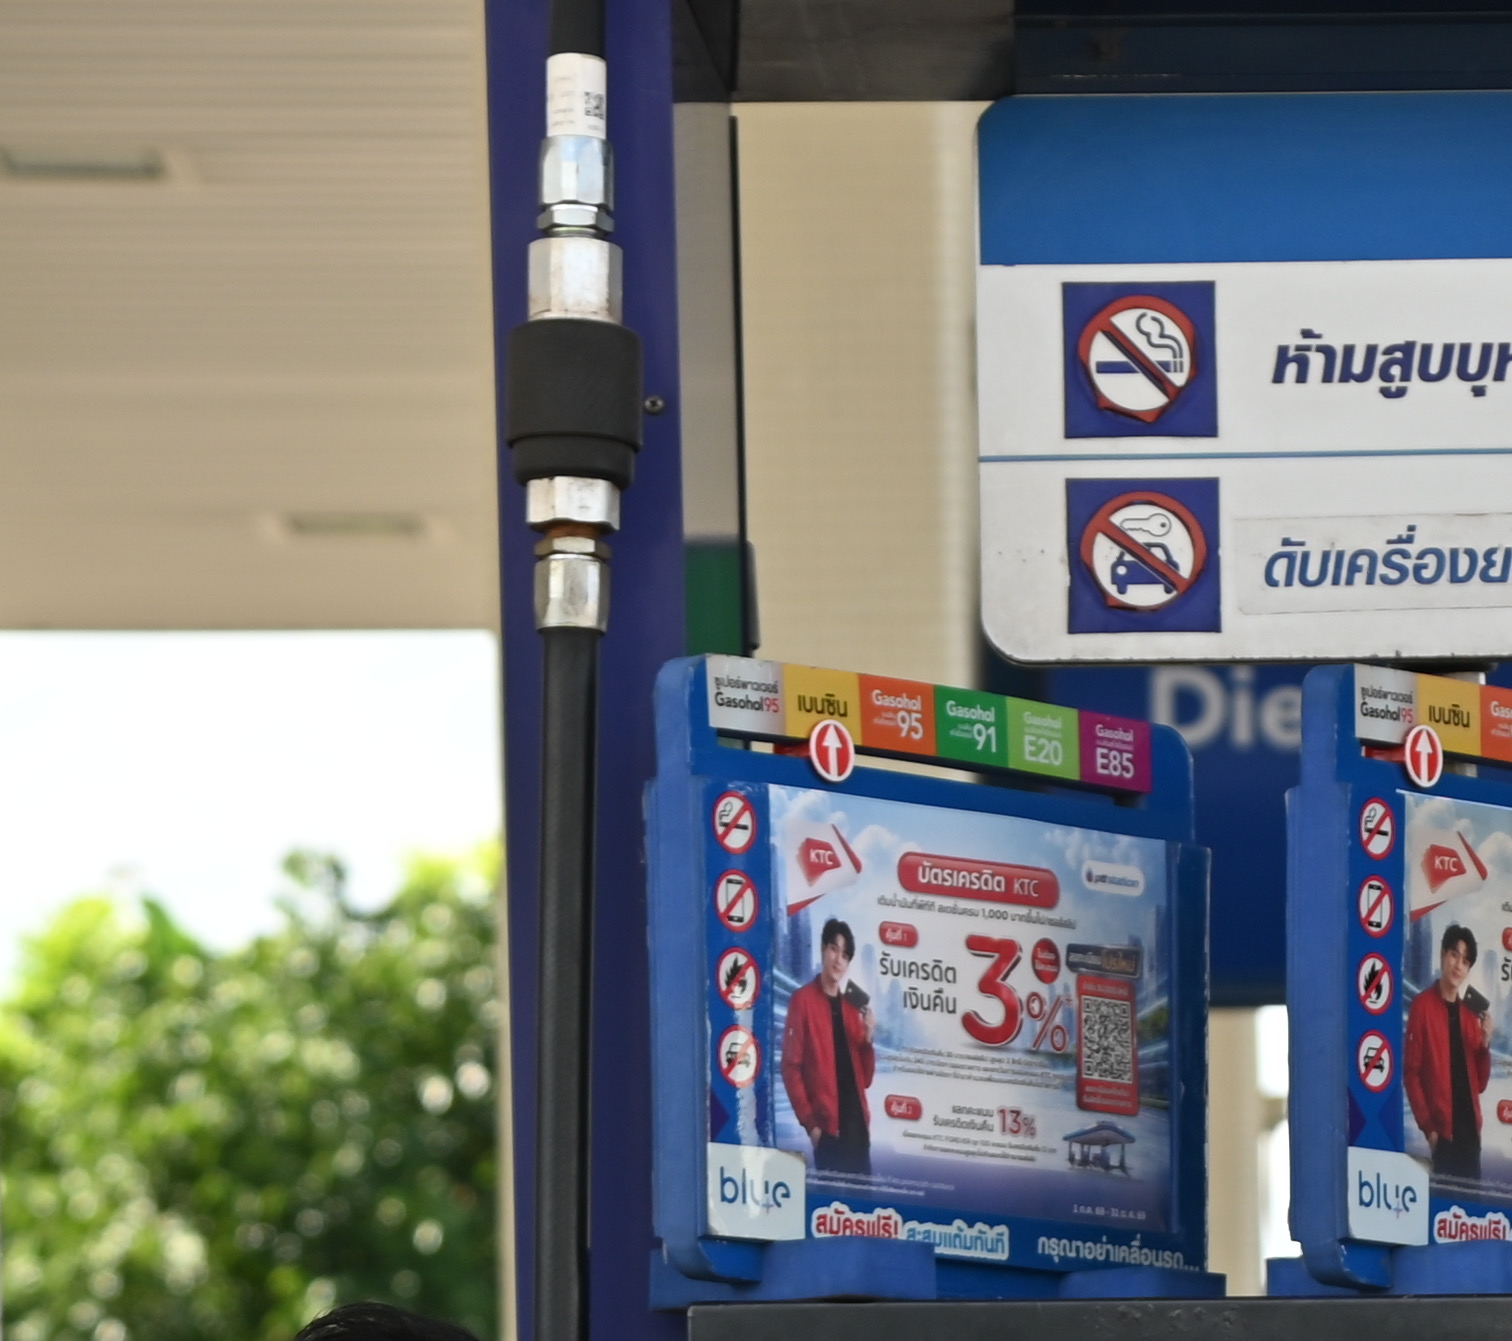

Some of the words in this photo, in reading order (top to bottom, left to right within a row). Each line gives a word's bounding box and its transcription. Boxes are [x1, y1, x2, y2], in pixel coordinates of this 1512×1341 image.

[797, 693, 848, 717] เบนซิน
[871, 689, 922, 710] Gasohol
[945, 700, 995, 722] Gasohol
[896, 711, 924, 740] 95
[1428, 703, 1471, 728] เบนซิน
[973, 723, 997, 752] 91
[1095, 724, 1134, 742] Gasohol
[1023, 735, 1063, 766] E20
[1096, 747, 1135, 779] E85
[809, 847, 834, 866] KTC
[1434, 856, 1459, 872] KTC
[917, 860, 1006, 893] บัตรเครดิต
[1013, 879, 1040, 898] KTC
[879, 951, 957, 985] รับเครดิต
[903, 987, 957, 1014] เงินคืน
[719, 1165, 791, 1210] blue
[1358, 1169, 1417, 1213] blue
